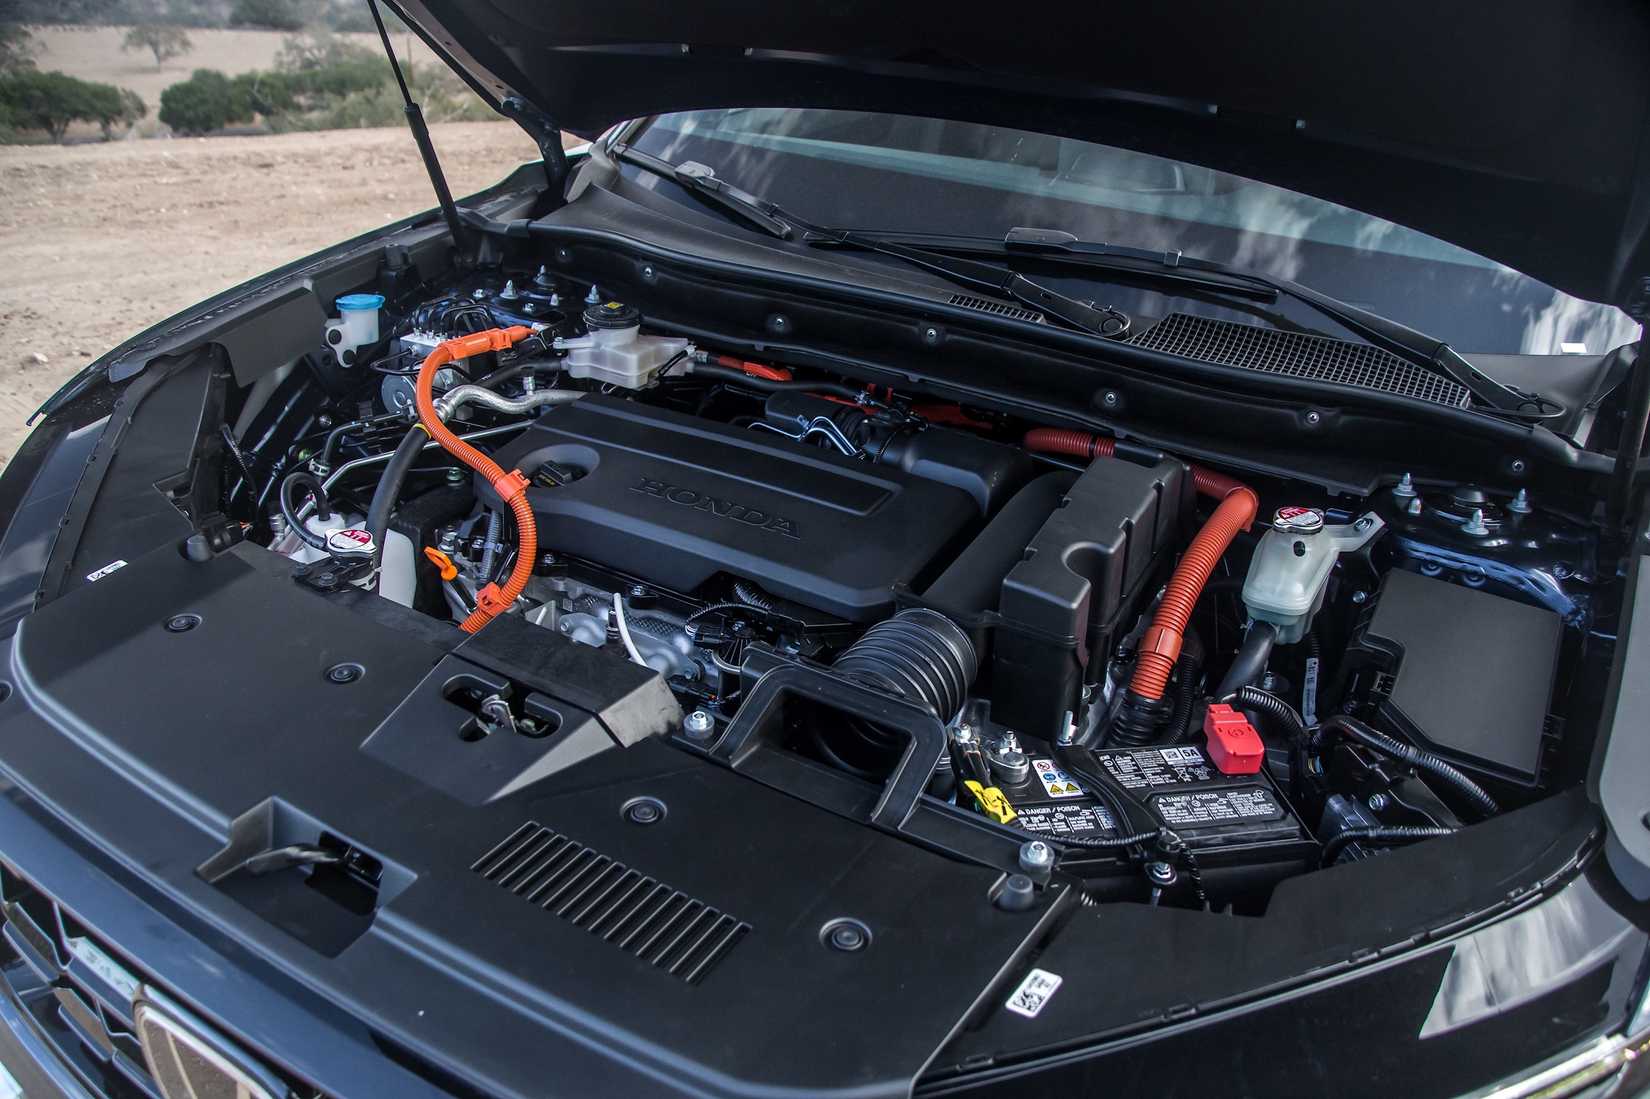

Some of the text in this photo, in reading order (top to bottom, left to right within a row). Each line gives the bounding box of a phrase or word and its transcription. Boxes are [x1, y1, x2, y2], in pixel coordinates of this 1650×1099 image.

[629, 477, 801, 541] HONDA
[1182, 749, 1200, 758] 5A
[1195, 793, 1219, 801] POISON
[1056, 805, 1080, 813] POISON
